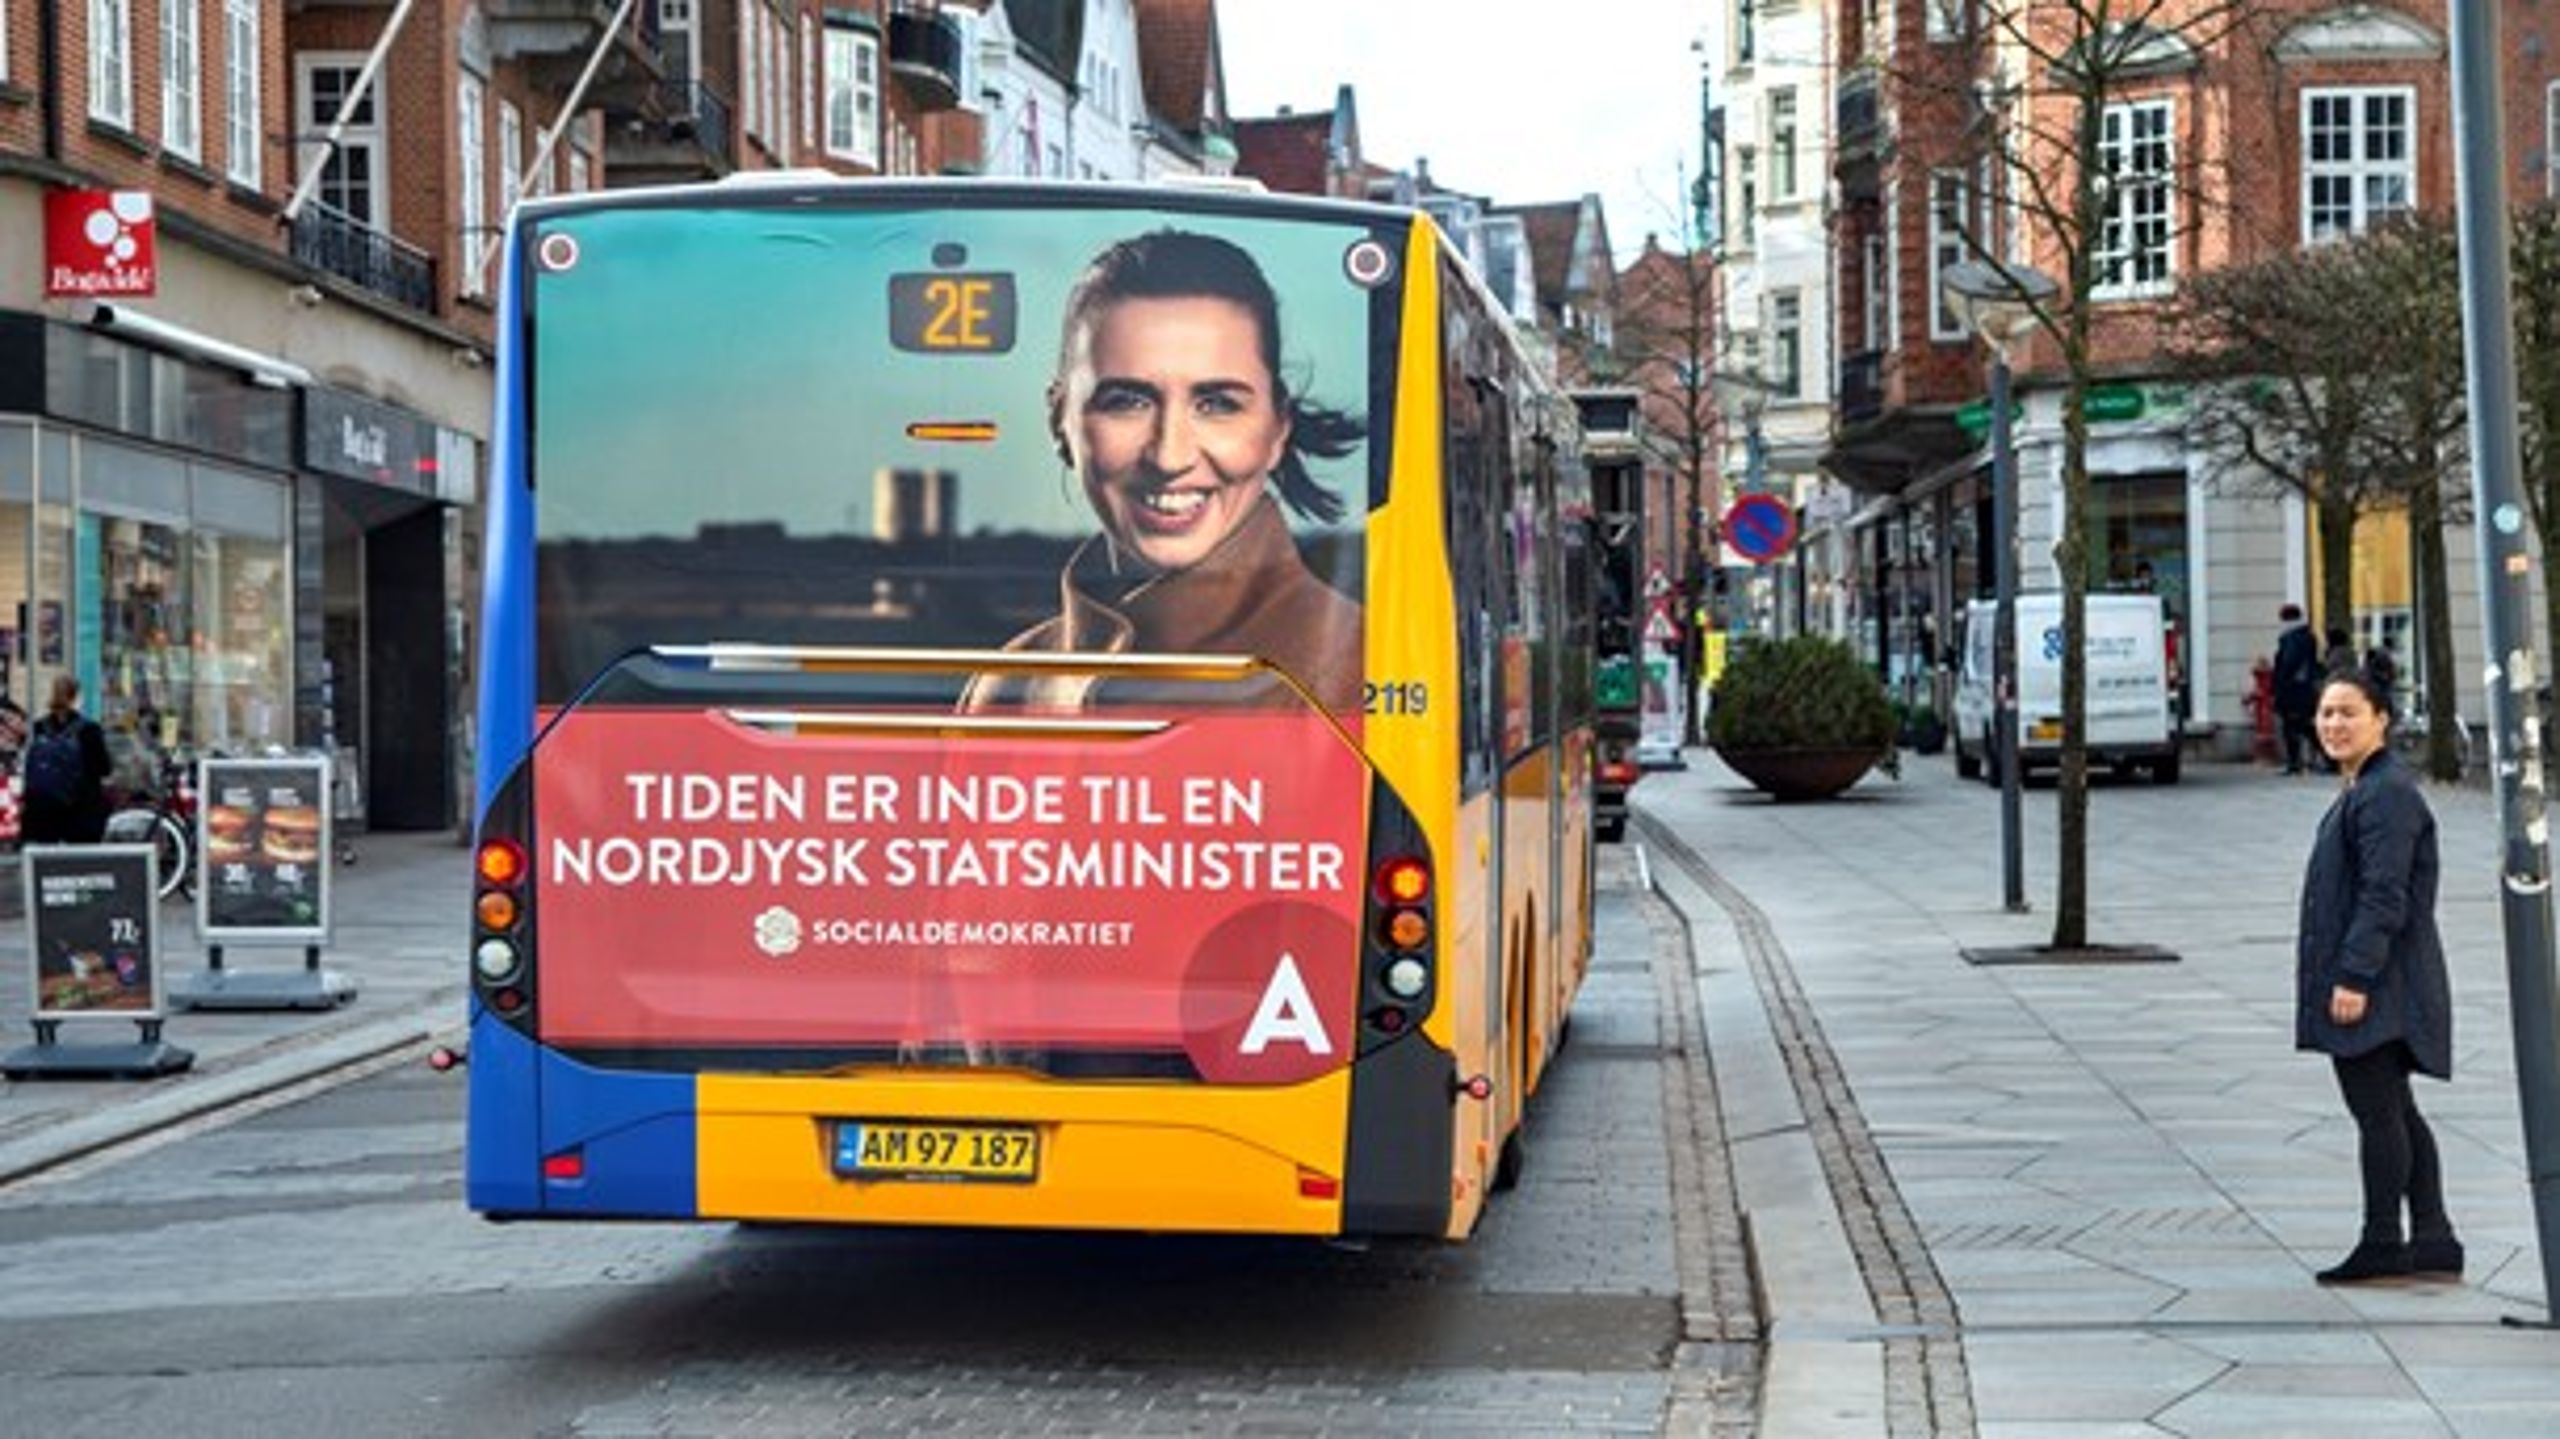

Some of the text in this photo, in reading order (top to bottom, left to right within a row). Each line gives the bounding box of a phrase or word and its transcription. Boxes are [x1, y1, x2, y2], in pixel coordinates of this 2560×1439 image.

[924, 279, 993, 346] 2E
[1362, 682, 1428, 716] 2119
[626, 774, 1263, 825] TIDEN ER INDE TIL EN
[552, 837, 1344, 891] NORDJYSK STATSMINISTER
[812, 921, 1134, 946] SOCIALDEMOKRATIET
[1237, 951, 1333, 1054] A
[862, 1131, 1031, 1168] AM 97 187
